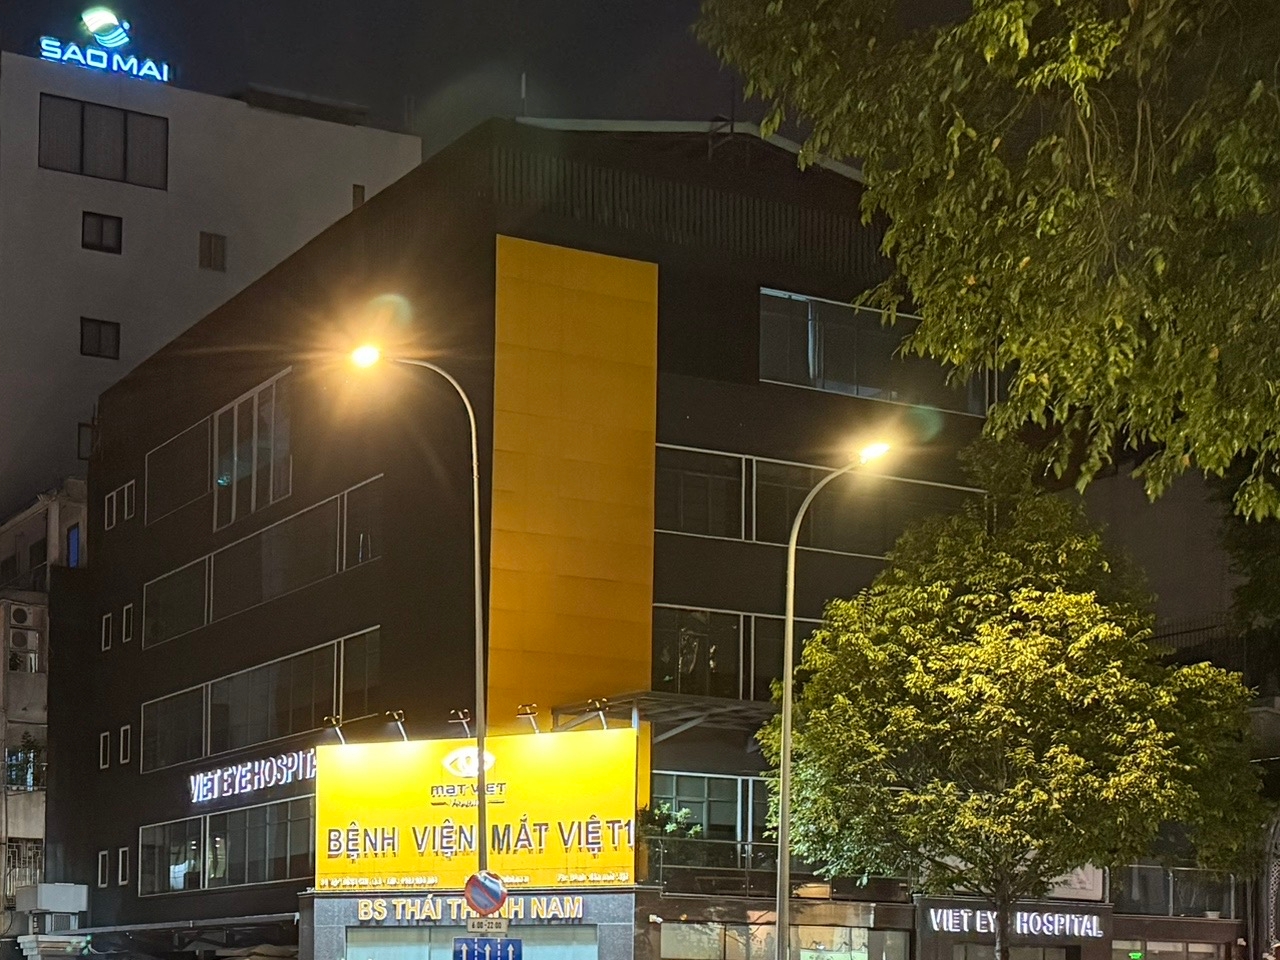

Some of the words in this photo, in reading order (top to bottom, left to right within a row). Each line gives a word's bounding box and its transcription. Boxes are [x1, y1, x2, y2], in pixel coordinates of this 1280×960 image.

[40, 38, 108, 69] SAO
[112, 53, 169, 82] MAI
[190, 768, 221, 803] VIET
[222, 761, 252, 797] EYE
[327, 820, 398, 863] BỆNH
[411, 818, 476, 861] VIỆN
[491, 813, 550, 854] MẮT
[357, 898, 388, 921] BS
[392, 893, 442, 920] THÁI
[447, 898, 524, 920] THNH
[530, 896, 584, 919] NAM
[929, 908, 972, 933] VIET
[975, 909, 1004, 934] EY
[1015, 910, 1105, 939] HOSPITAL
